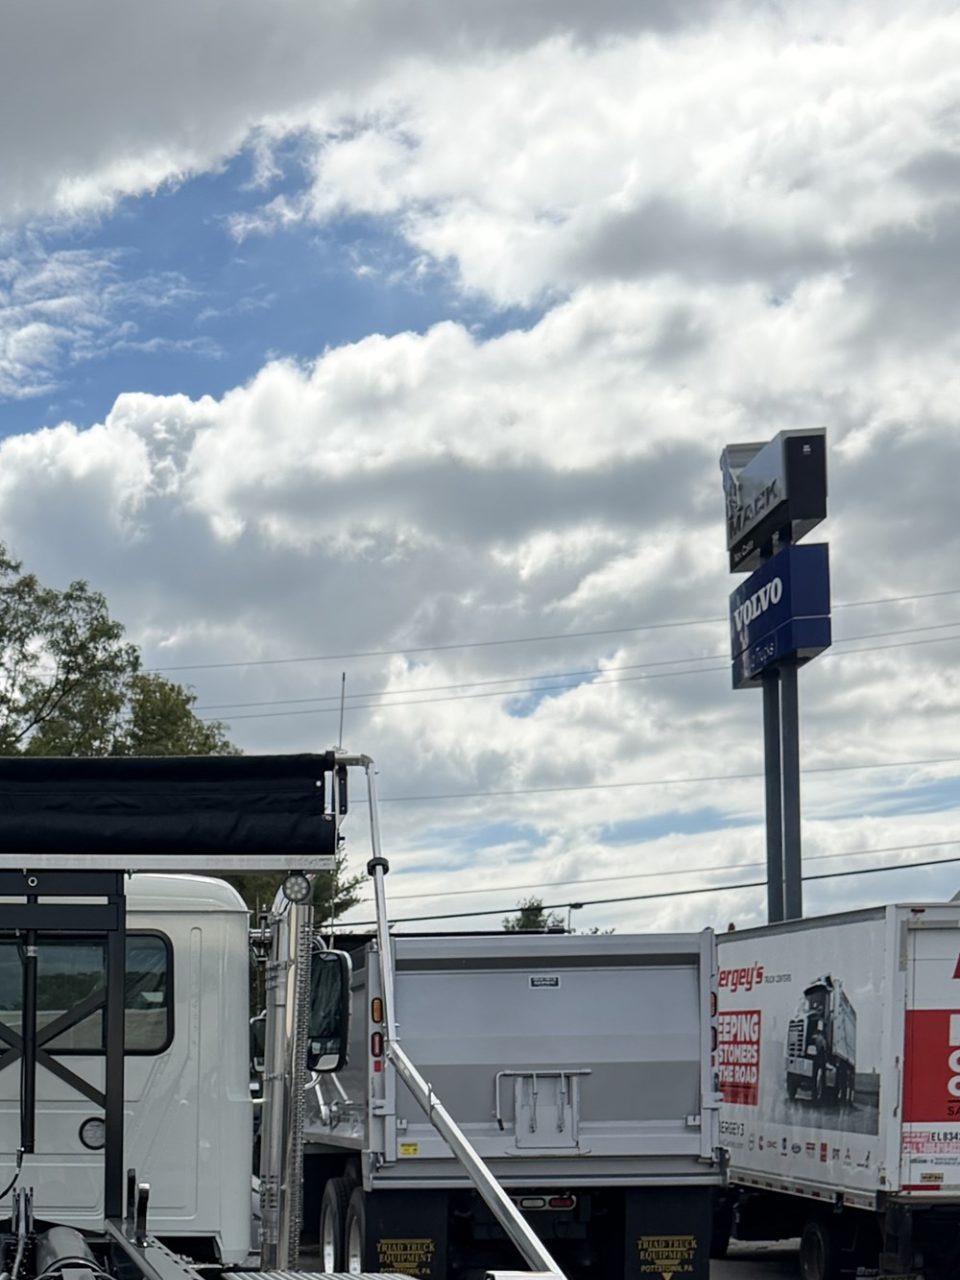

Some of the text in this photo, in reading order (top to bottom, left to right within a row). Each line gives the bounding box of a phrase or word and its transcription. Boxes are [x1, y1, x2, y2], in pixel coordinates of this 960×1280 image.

[733, 577, 783, 632] VOLVO
[717, 961, 765, 993] ergey's
[719, 1014, 759, 1042] EEPING
[719, 1044, 758, 1064] STOMERS
[735, 1065, 758, 1083] ROAD
[931, 1131, 960, 1142] EL834
[376, 1242, 436, 1252] TRIAD TRUCK
[637, 1239, 697, 1249] TRIAD TRUCK
[379, 1253, 432, 1263] EQUIPMENT
[640, 1250, 695, 1261] EQUIPMENT
